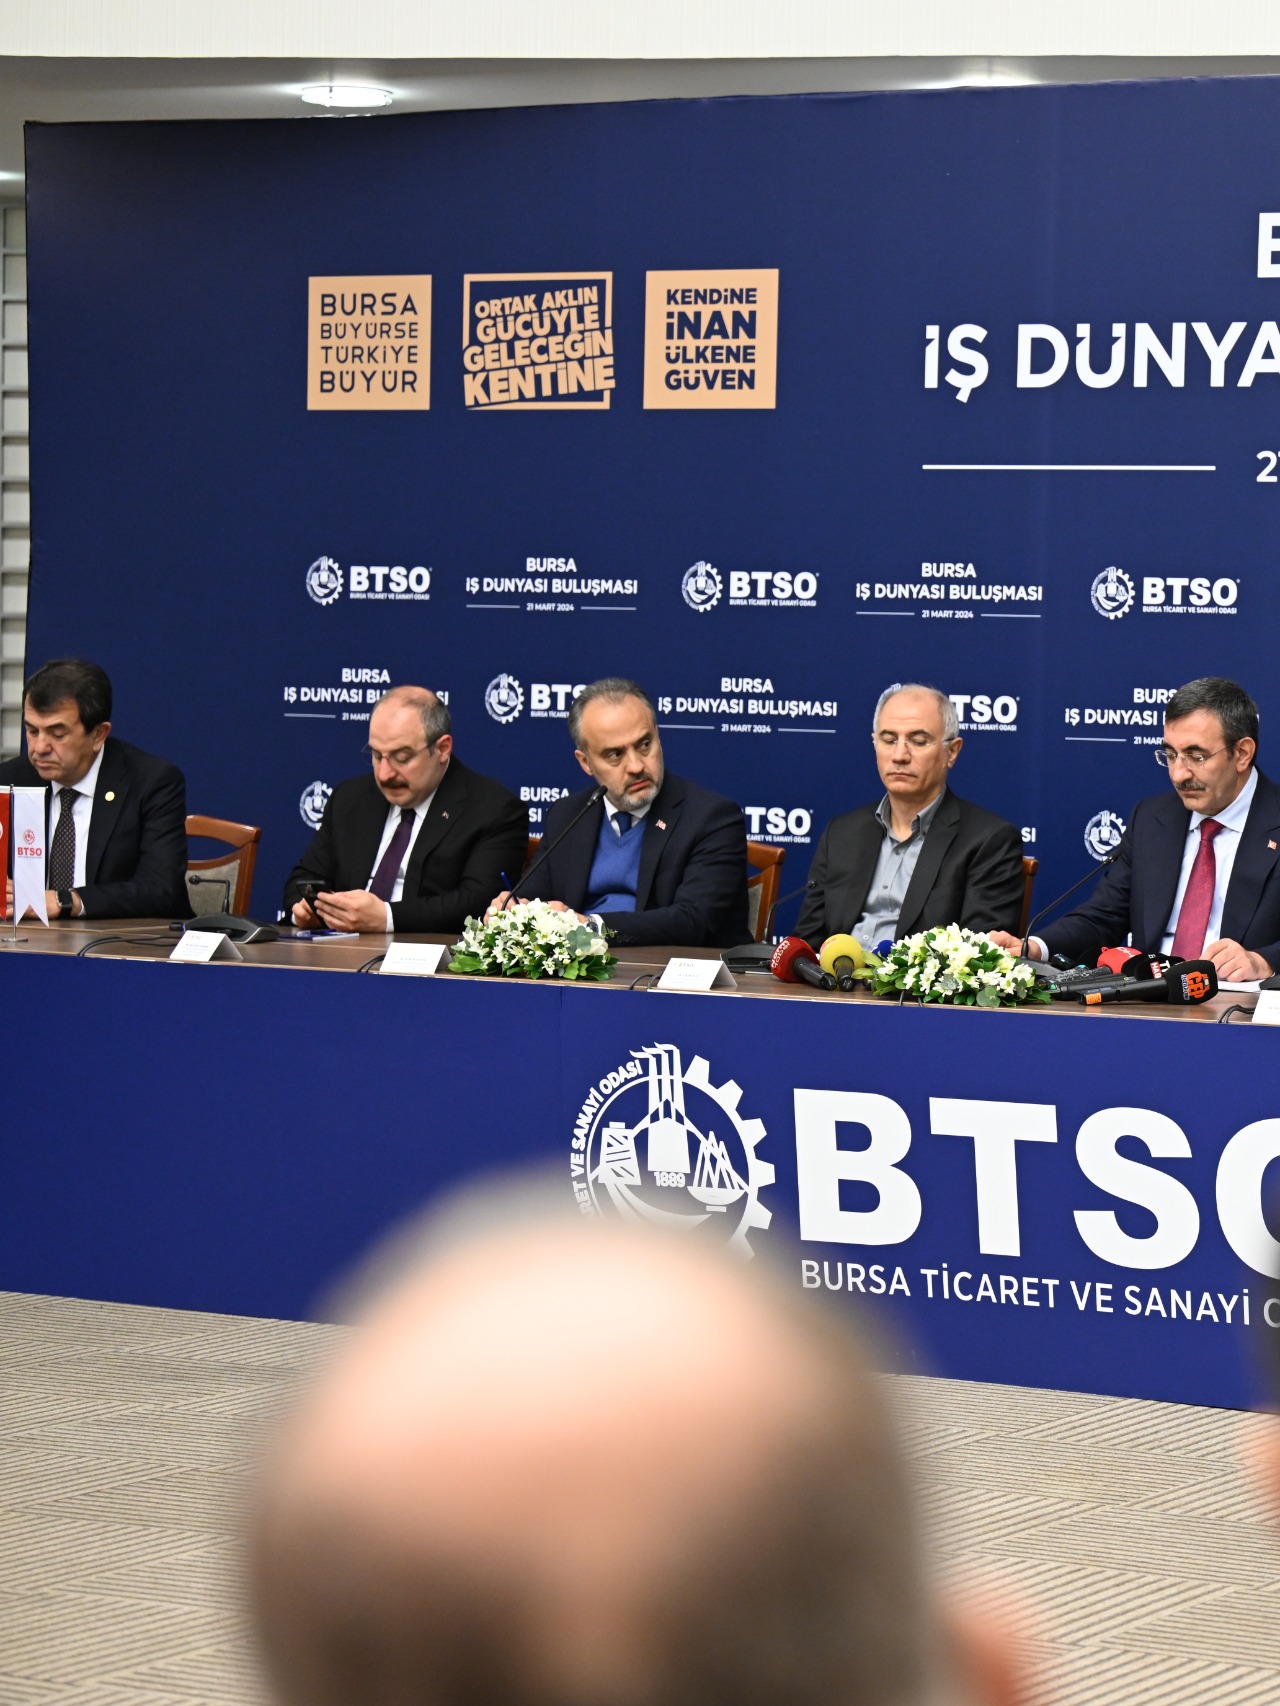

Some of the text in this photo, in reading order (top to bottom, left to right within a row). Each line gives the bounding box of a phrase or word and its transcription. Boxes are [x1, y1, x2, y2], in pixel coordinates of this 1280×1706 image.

[321, 293, 417, 316] BURSA
[474, 286, 598, 319] ORTAK AKLIN
[667, 288, 756, 305] KENDİNE
[321, 322, 417, 339] BÜYÜRSE
[476, 304, 600, 343] GÜCÜYLE
[666, 311, 756, 339] İNAN
[321, 346, 417, 363] TÜRKİYE
[666, 346, 755, 364] ÜLKENE
[925, 324, 988, 403] İŞ
[320, 371, 417, 393] BÜYÜR
[463, 356, 616, 406] KENTİNE
[665, 370, 755, 390] GÜVEN
[527, 558, 577, 572] BURSA
[922, 563, 976, 577] BURSA
[350, 566, 431, 595] BTSO
[730, 571, 818, 600] BTSO
[1143, 577, 1240, 608] BTSO
[527, 602, 574, 612] 21 MART 2024
[922, 609, 973, 619] 21 MART 2024
[1143, 605, 1237, 615] BURSA TİCARET VE SANAYİ ODASI
[342, 668, 390, 683] BURSA
[721, 678, 773, 693] BURSA
[530, 684, 587, 711] BT
[1134, 688, 1177, 703] BURS
[343, 712, 370, 721] 21 MART
[722, 723, 771, 734] 21 MART 2024
[1134, 736, 1141, 745] 21
[521, 787, 569, 802] BURSA
[745, 807, 812, 837] TSO
[17, 846, 43, 856] BTSO
[599, 1059, 643, 1095] ODASI
[653, 1171, 686, 1188] 1889
[798, 1260, 910, 1296] BURSA
[921, 1264, 1059, 1307] TİCARET
[1070, 1281, 1113, 1312] VE
[1125, 1286, 1249, 1325] SANAYİ
